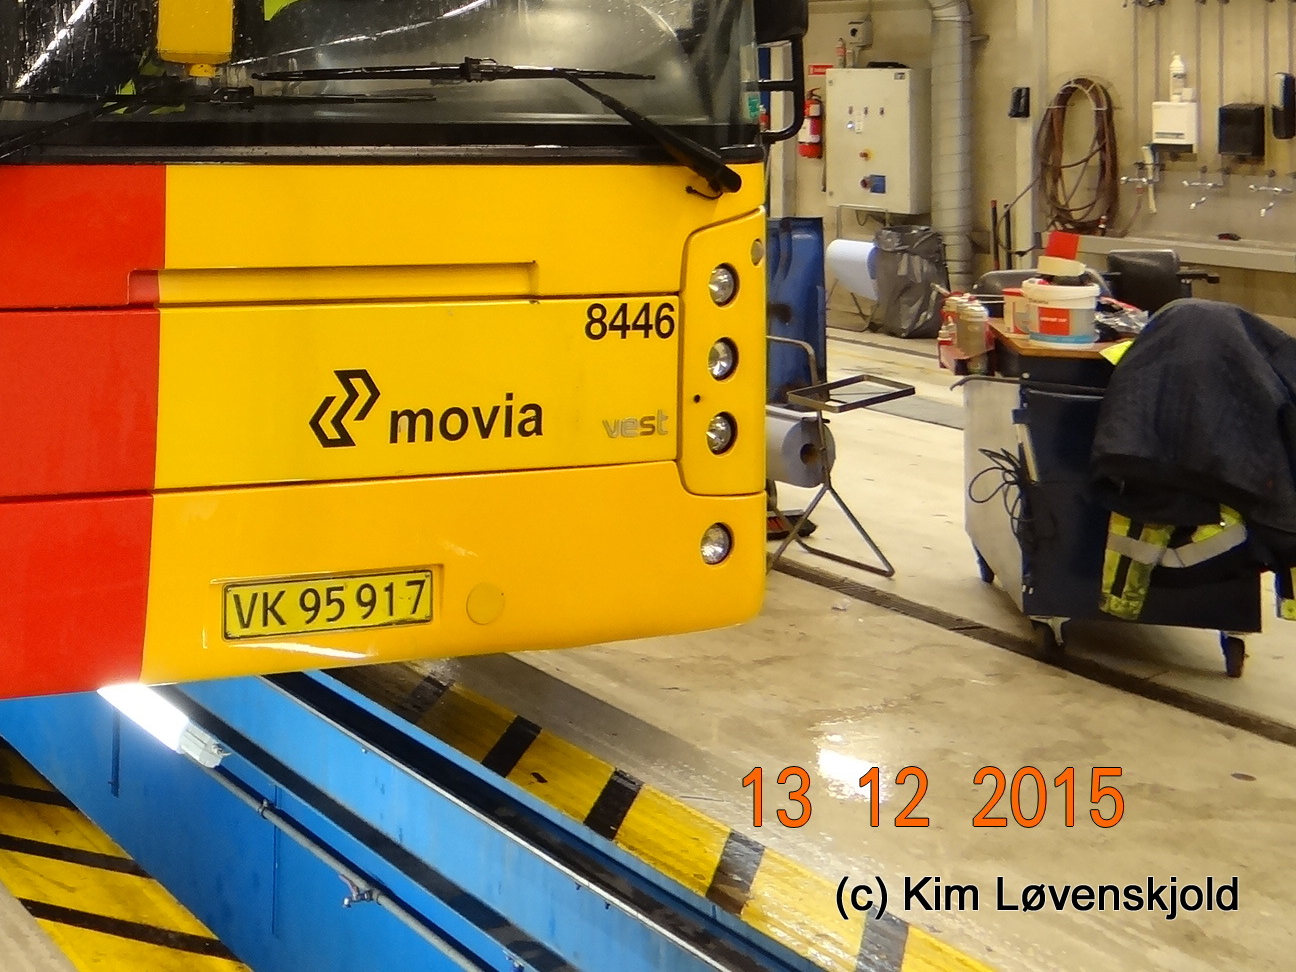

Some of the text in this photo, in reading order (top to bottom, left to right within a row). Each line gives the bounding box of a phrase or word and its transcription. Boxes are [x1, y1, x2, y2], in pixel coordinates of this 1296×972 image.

[584, 302, 675, 340] 8446
[389, 392, 543, 444] movia
[602, 409, 669, 438] vest
[233, 579, 426, 629] VK 95 917
